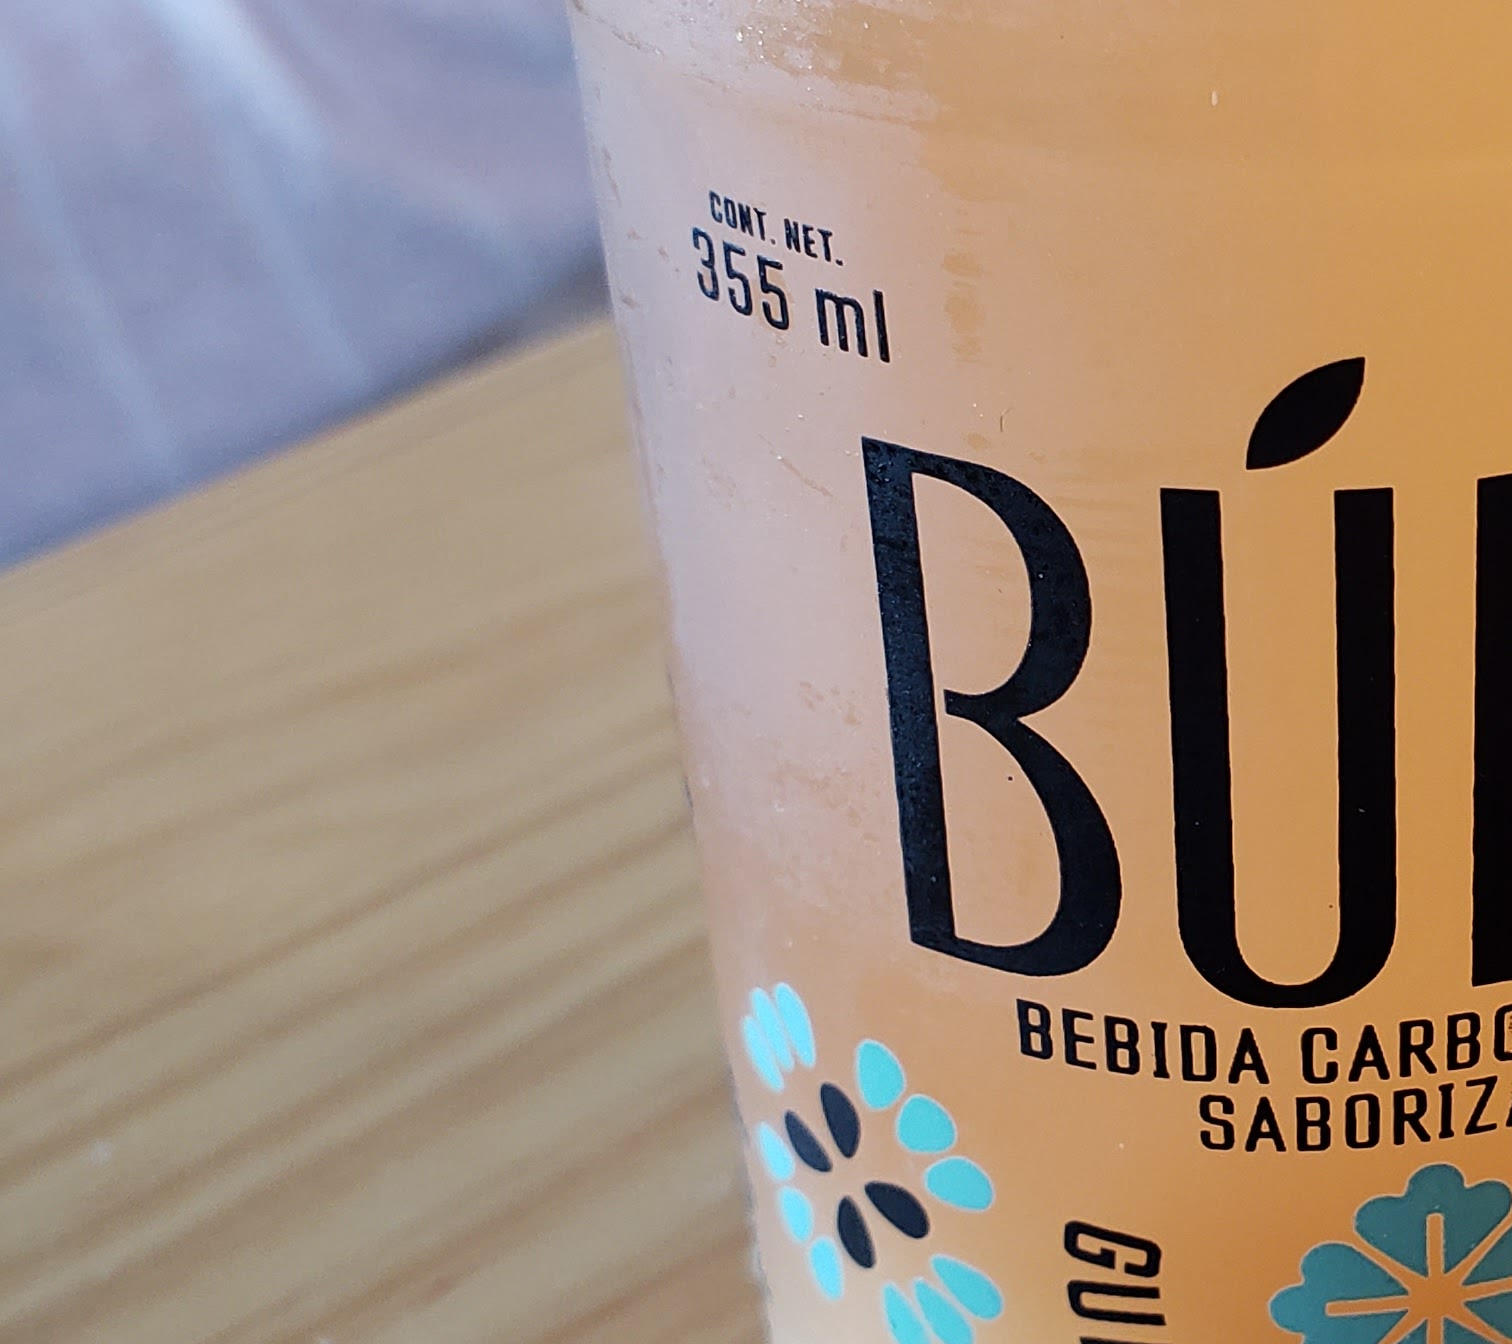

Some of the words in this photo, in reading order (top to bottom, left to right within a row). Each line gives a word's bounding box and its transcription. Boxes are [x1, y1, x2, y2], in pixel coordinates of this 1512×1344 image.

[708, 189, 777, 245] CONT.
[784, 218, 843, 266] NET.
[691, 226, 790, 331] 355
[814, 287, 891, 363] ml
[1016, 998, 1271, 1086] BEBIDA
